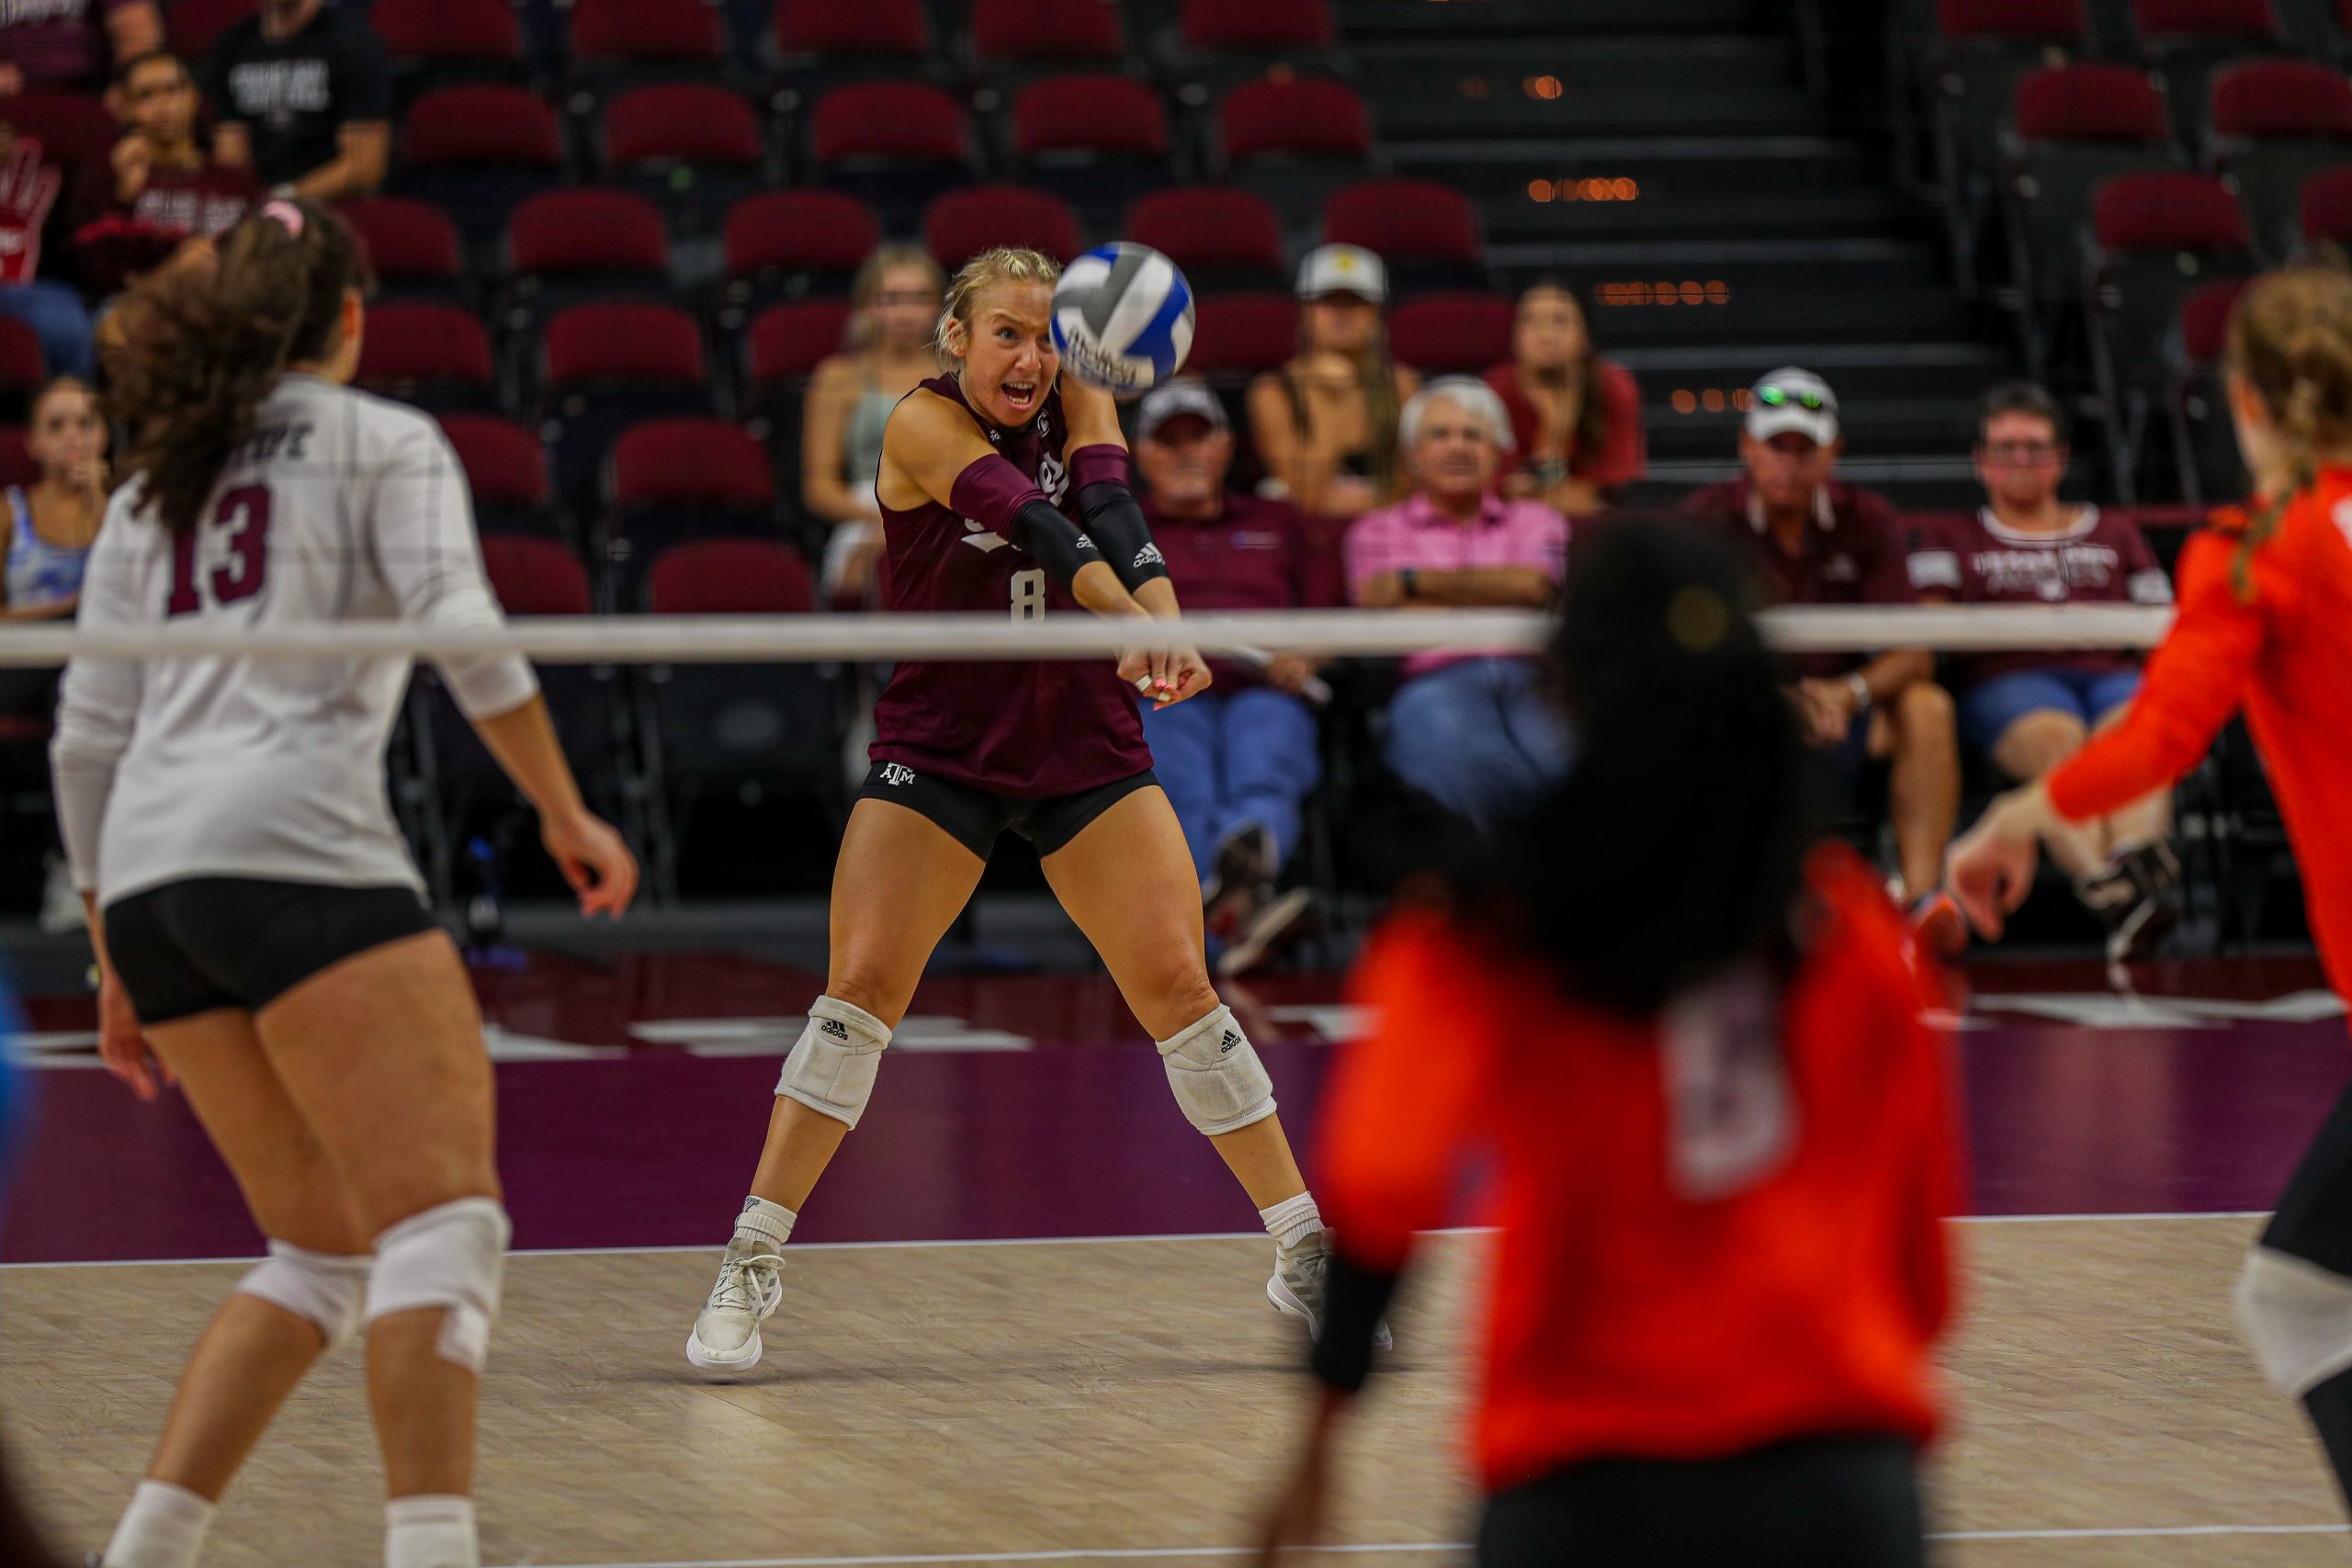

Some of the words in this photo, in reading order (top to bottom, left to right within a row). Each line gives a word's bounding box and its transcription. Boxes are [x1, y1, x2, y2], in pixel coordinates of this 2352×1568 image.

[167, 482, 271, 616] 13
[1011, 568, 1046, 626] 8
[820, 1023, 849, 1041] adidas
[1220, 1035, 1242, 1054] adidas
